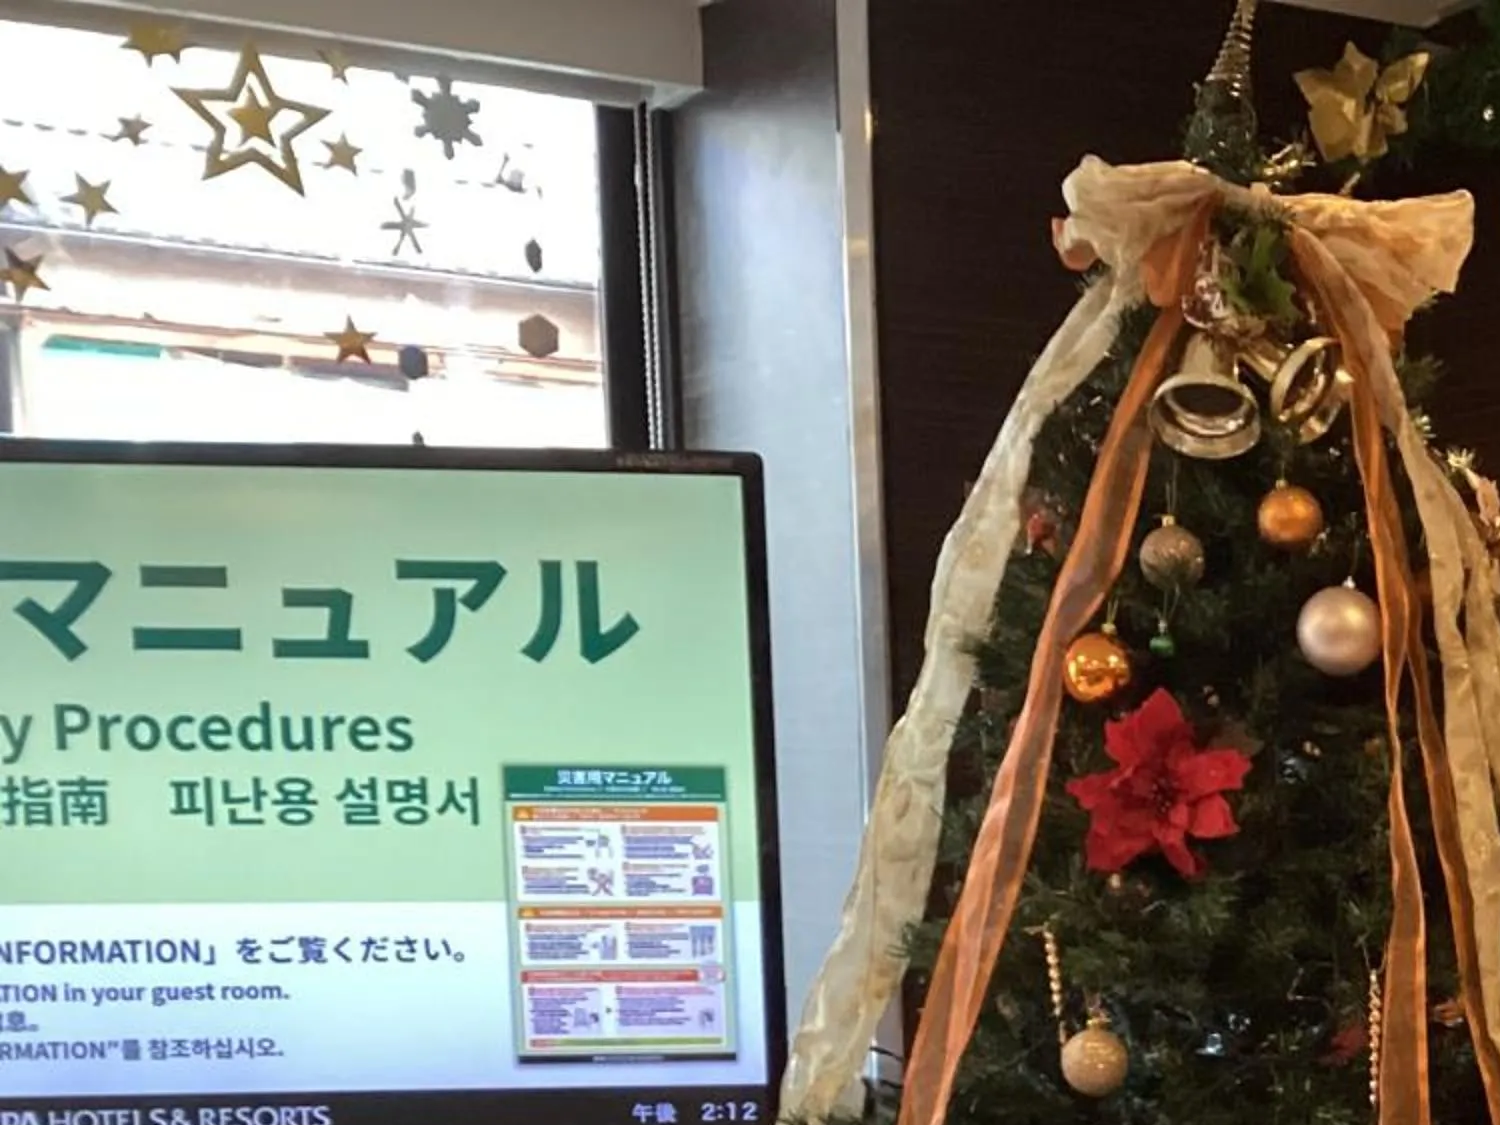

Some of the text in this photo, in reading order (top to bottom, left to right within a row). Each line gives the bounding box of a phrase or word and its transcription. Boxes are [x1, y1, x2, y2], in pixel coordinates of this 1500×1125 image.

[0, 558, 640, 665] マニュアル
[0, 701, 415, 765] y Procedures
[0, 776, 108, 826] 指南
[169, 776, 481, 827] 피난용 설명서
[63, 982, 86, 1003] in
[91, 984, 146, 1006] your
[152, 982, 215, 1006] guest
[220, 984, 290, 1001] room.
[148, 1036, 285, 1061] 참조하십시오.
[632, 1102, 677, 1123] 午後
[701, 1102, 758, 1121] 2:12
